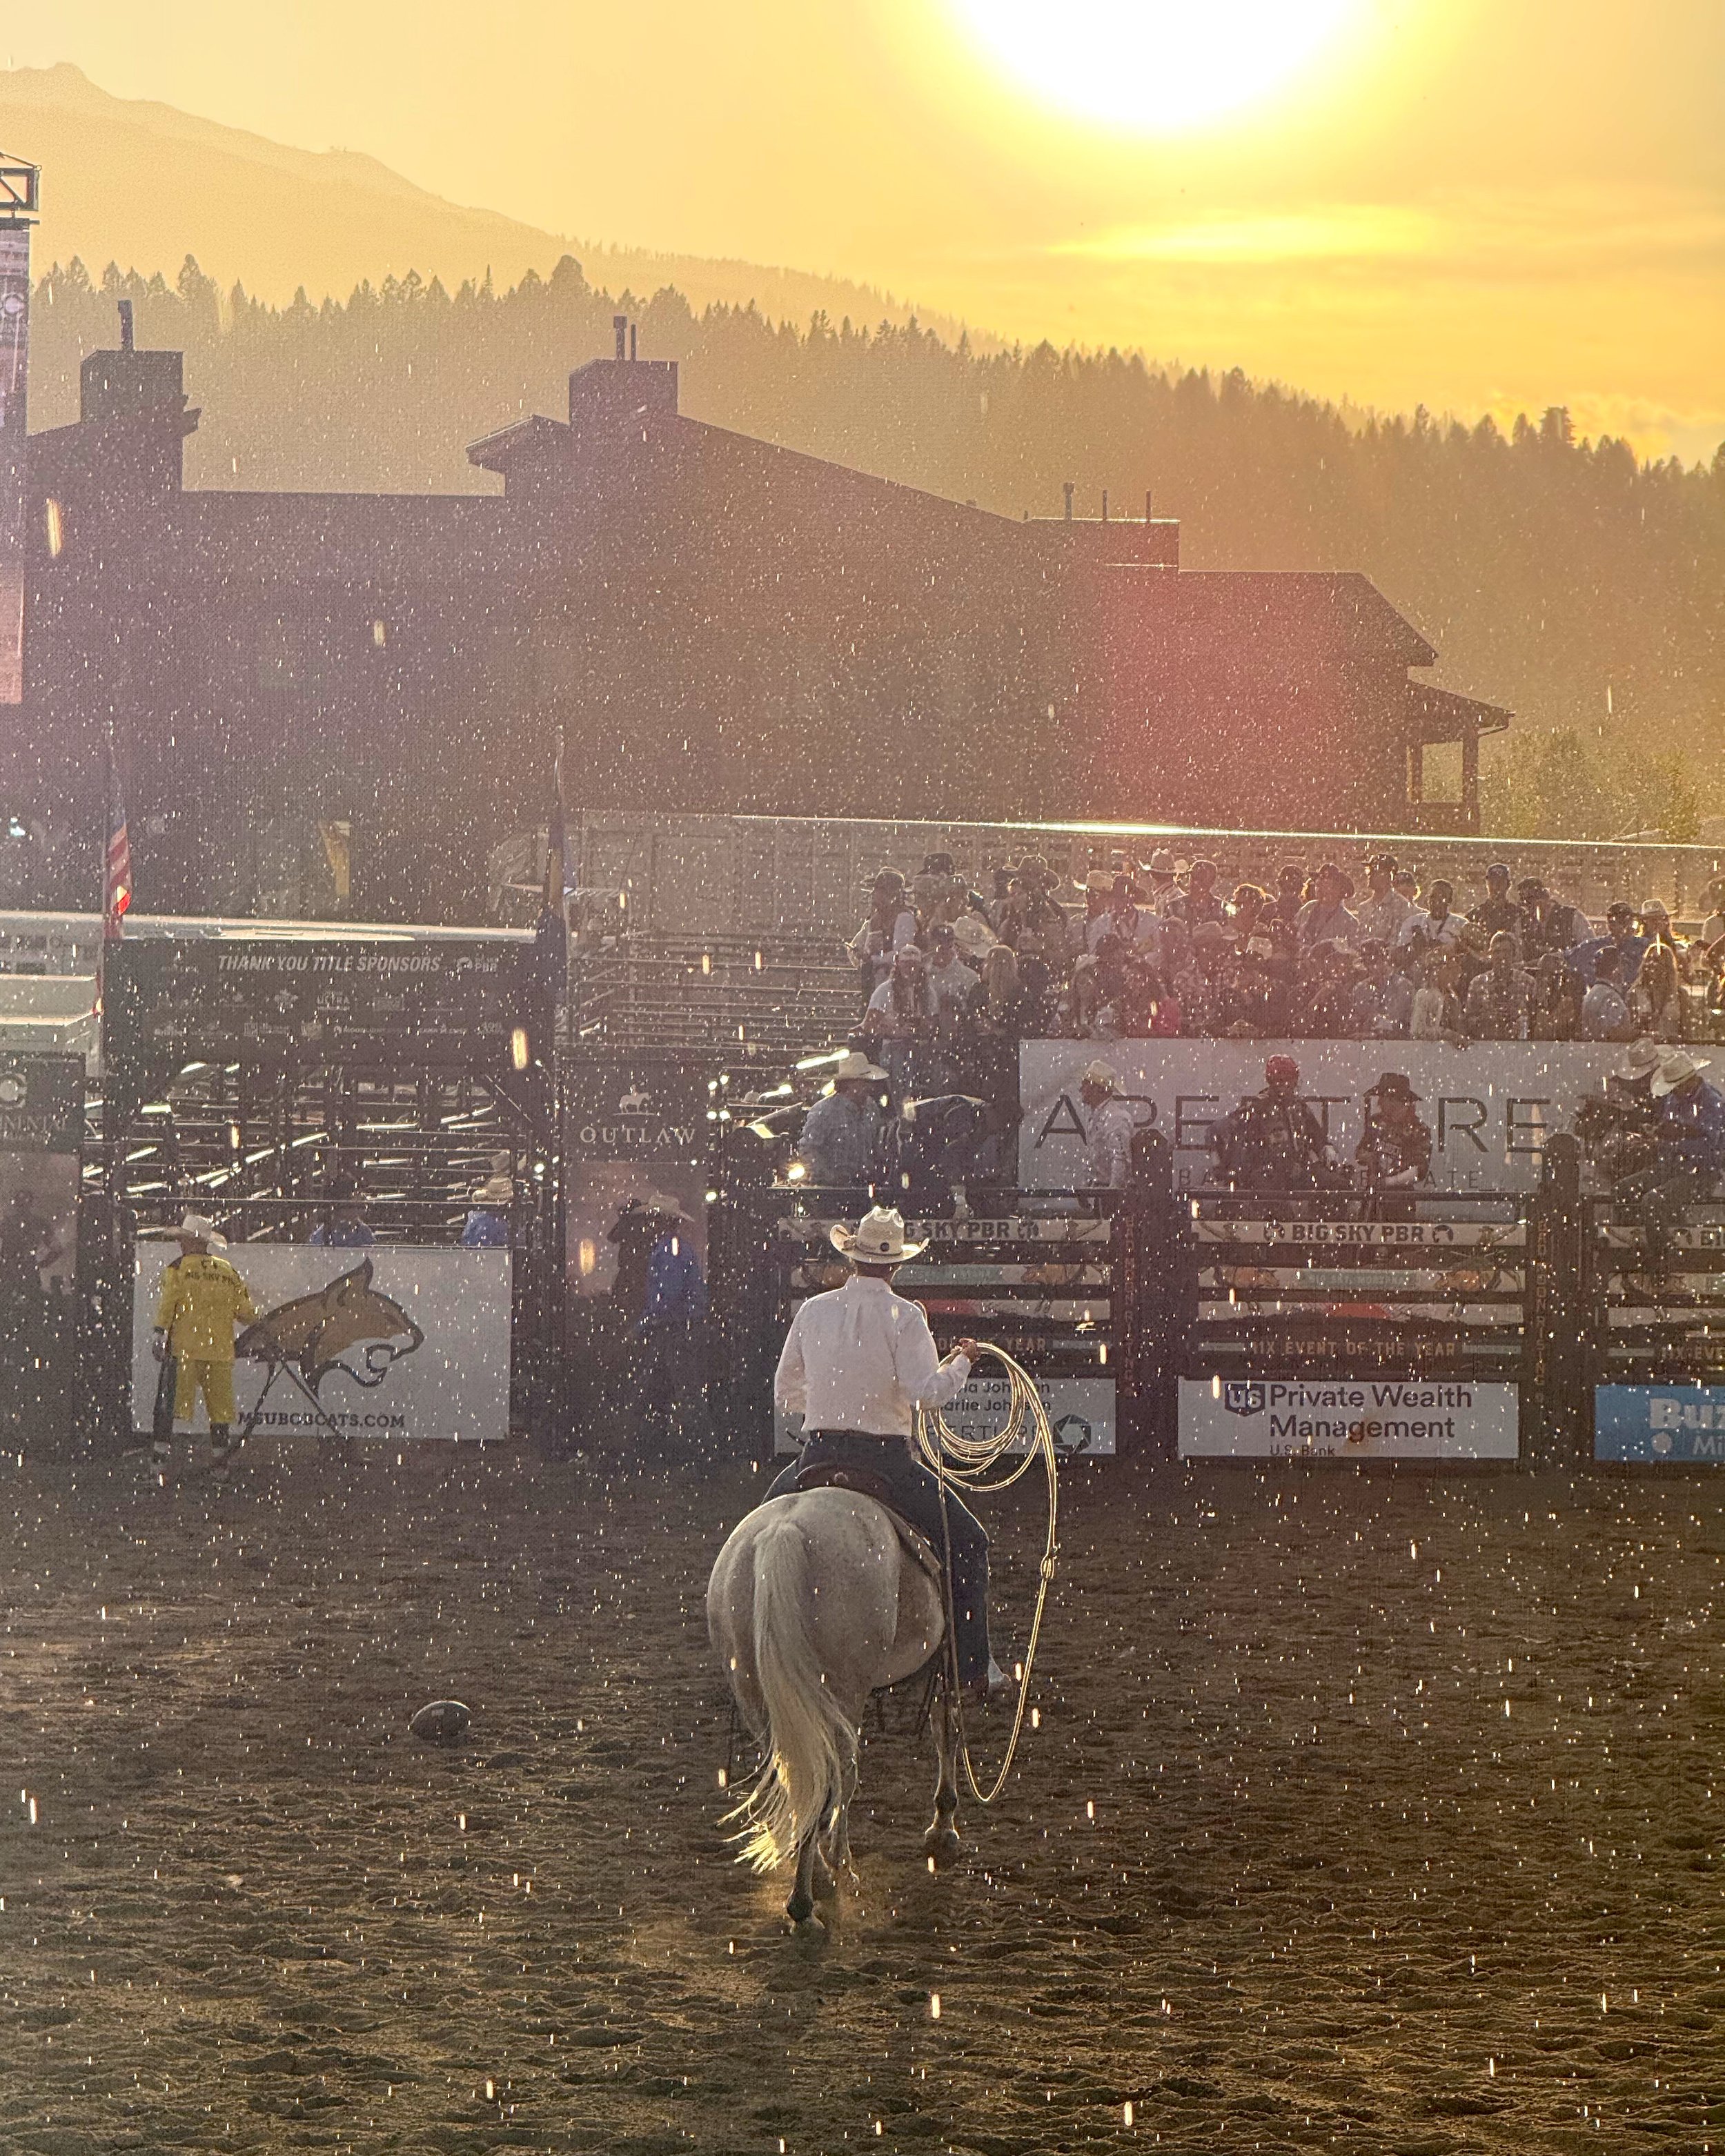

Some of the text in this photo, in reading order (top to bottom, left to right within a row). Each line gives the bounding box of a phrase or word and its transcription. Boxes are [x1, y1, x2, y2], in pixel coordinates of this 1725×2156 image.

[219, 955, 273, 971] THANK
[277, 956, 308, 971] YOU
[313, 956, 353, 971] TITLE
[356, 956, 442, 972] SPONSORS
[1034, 1094, 1550, 1154] APETRE
[580, 1127, 696, 1144] OUTLAW
[921, 1221, 1010, 1238] SKY PBR
[1292, 1225, 1424, 1242] BIG SKY PBR
[1005, 1338, 1046, 1352] YEAR
[1285, 1341, 1337, 1355] EVENT
[1346, 1341, 1366, 1356] OF
[1374, 1341, 1405, 1356] THE
[1414, 1341, 1455, 1357] YEAR
[1270, 1383, 1472, 1408] Private Wealth
[940, 1399, 980, 1412] arlie
[1270, 1414, 1455, 1443] Management
[1301, 1445, 1336, 1457] Bank
